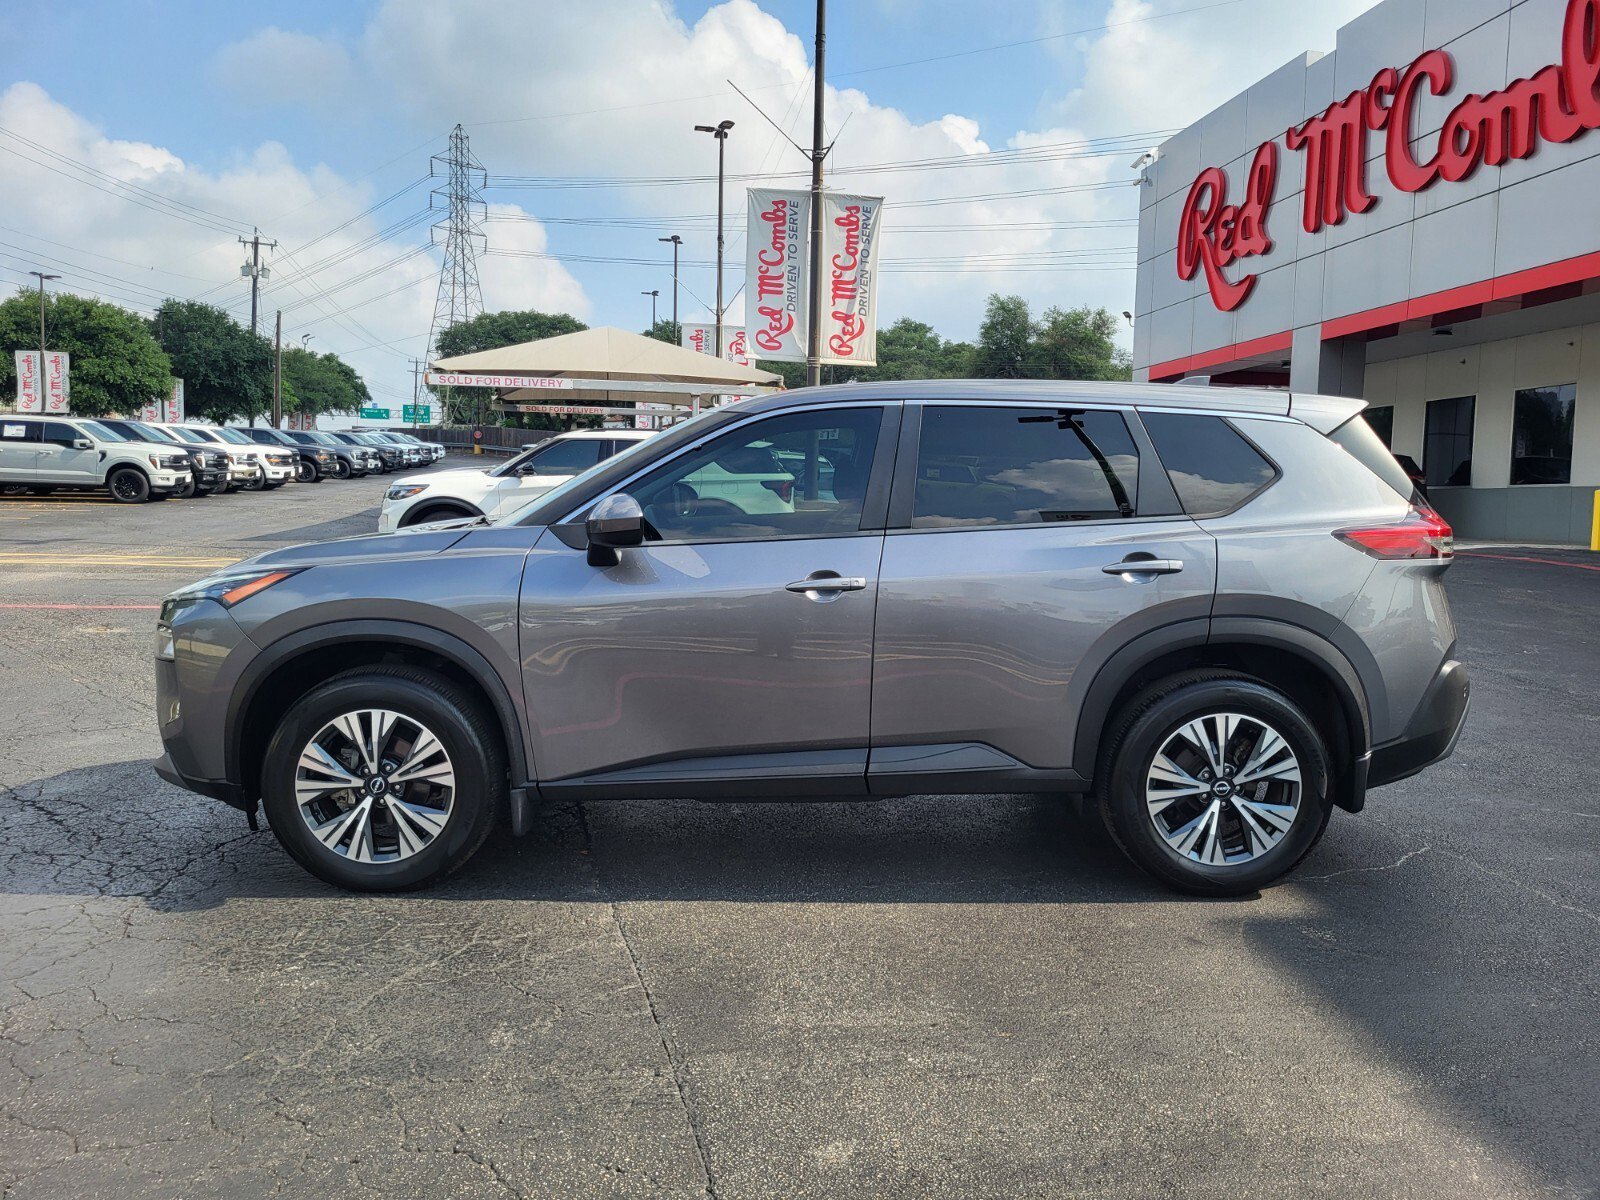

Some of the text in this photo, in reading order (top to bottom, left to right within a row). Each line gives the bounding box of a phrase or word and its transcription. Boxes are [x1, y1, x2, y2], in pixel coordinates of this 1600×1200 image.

[755, 200, 794, 351] Red McCombs
[787, 200, 799, 312] DRIVEN TO SERVE
[829, 205, 865, 356] Red McCombs
[858, 206, 872, 316] DRIVEN TO SERVE
[1177, 141, 1278, 312] Red
[21, 393, 37, 409] Red
[50, 393, 65, 410] Red
[438, 375, 564, 388] SOLD FOR DELIVERY
